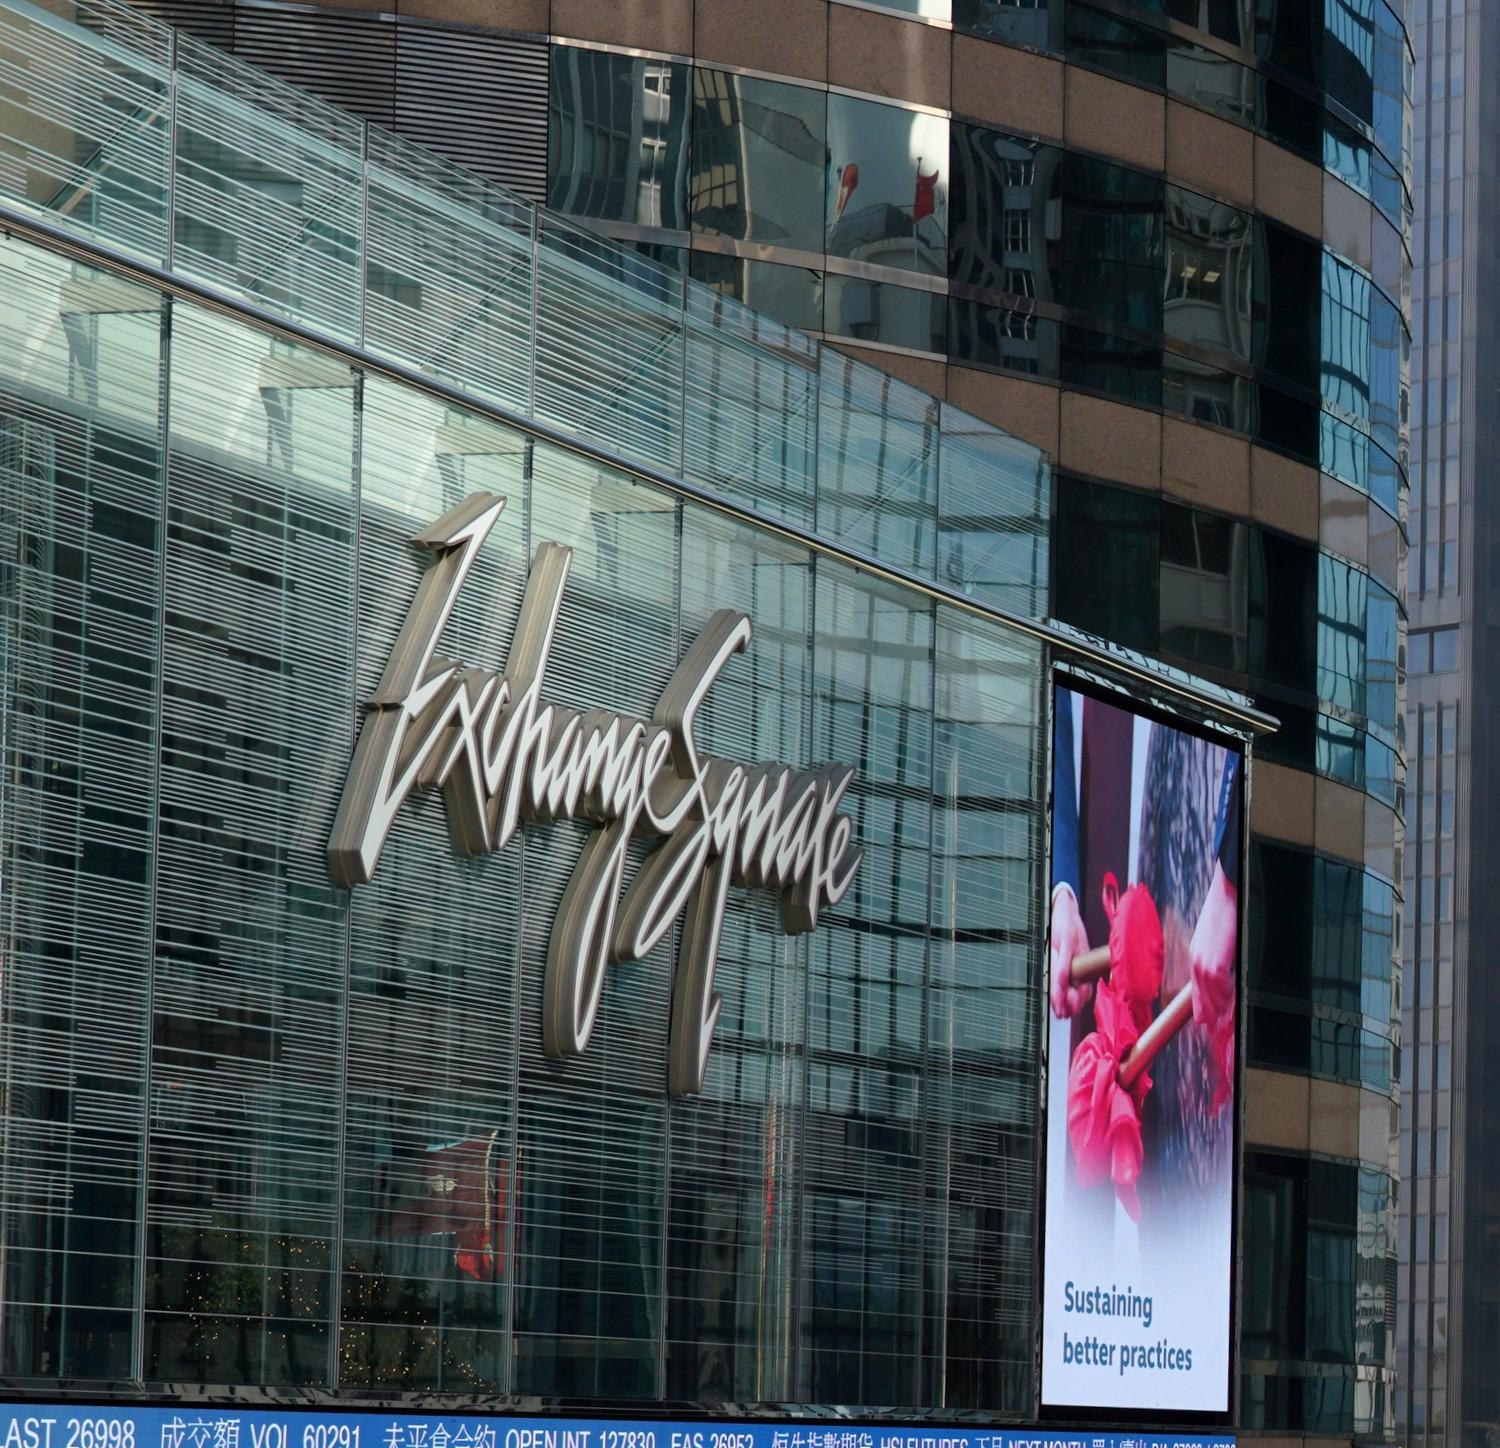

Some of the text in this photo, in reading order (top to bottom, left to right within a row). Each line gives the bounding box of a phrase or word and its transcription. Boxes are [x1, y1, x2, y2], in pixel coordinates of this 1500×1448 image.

[328, 492, 865, 1098] Exchange Square
[1064, 1281, 1153, 1328] Sustaining
[1063, 1332, 1192, 1376] better practices
